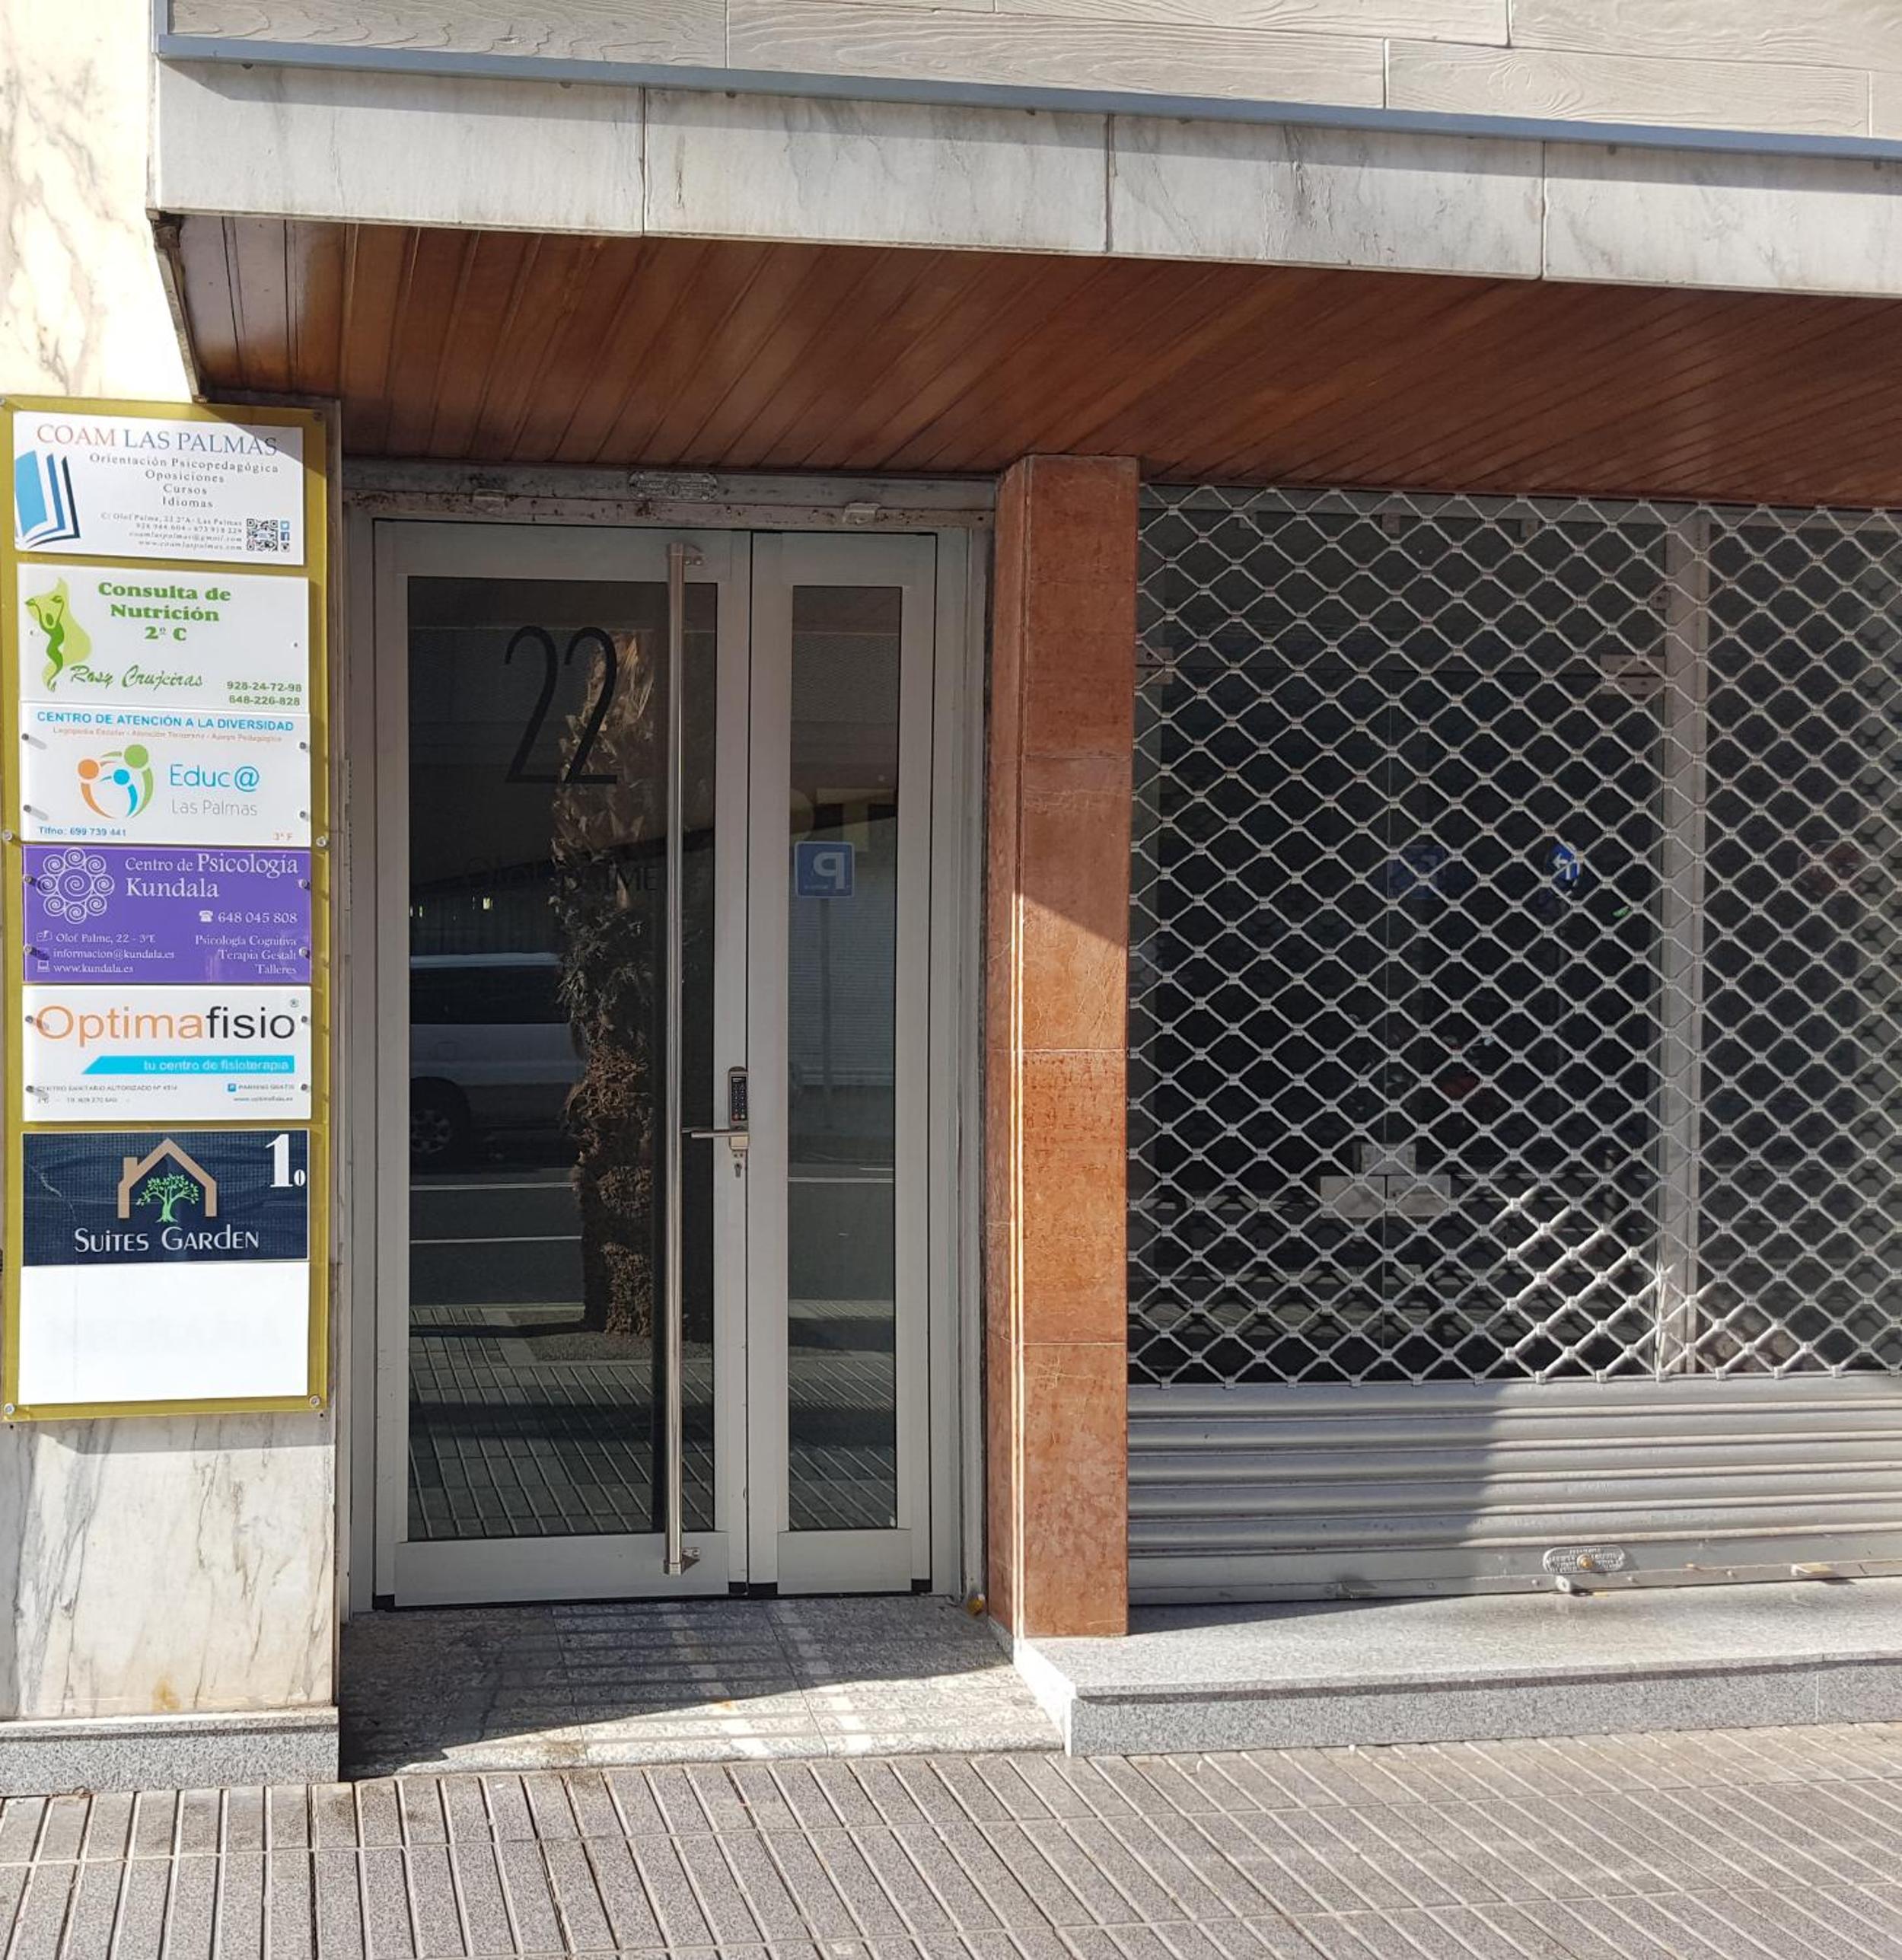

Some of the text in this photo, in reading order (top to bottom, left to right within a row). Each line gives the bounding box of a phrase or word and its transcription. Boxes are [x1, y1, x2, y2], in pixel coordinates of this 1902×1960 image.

[37, 424, 278, 456] COAM LAS PALMAS
[89, 452, 279, 474] Orientación Psicopedagógica
[145, 469, 225, 484] Oposiciones
[163, 483, 208, 496] Cursos
[162, 496, 214, 508] Idiomas
[97, 582, 231, 602] Consulta de
[110, 604, 220, 623] Nutrición
[173, 626, 187, 642] C
[69, 664, 113, 689] Rosy
[226, 680, 303, 693] 928-24-72-98
[228, 694, 301, 706] 648-226-828
[504, 625, 618, 785] 22
[37, 711, 294, 731] CENTRO DE ATENCIÓN A LA DIVERSIDAD
[170, 763, 260, 792] Educ@
[170, 798, 258, 817] Las Palmas
[70, 827, 86, 836] 699
[125, 852, 298, 878] Centro de Psicología
[125, 877, 220, 899] Kundala
[218, 912, 298, 923] 648 045 808
[55, 933, 77, 943] Olof
[81, 933, 113, 945] Palme,
[116, 934, 130, 943] 22
[195, 934, 297, 948] Psicología Cognitiva
[218, 948, 296, 962] Terapia Gestalt
[53, 963, 134, 974] www.kundala.es
[255, 964, 297, 975] Talleres
[36, 1005, 295, 1047] Optimafisio
[143, 1059, 290, 1073] tu centro de fisioterapia
